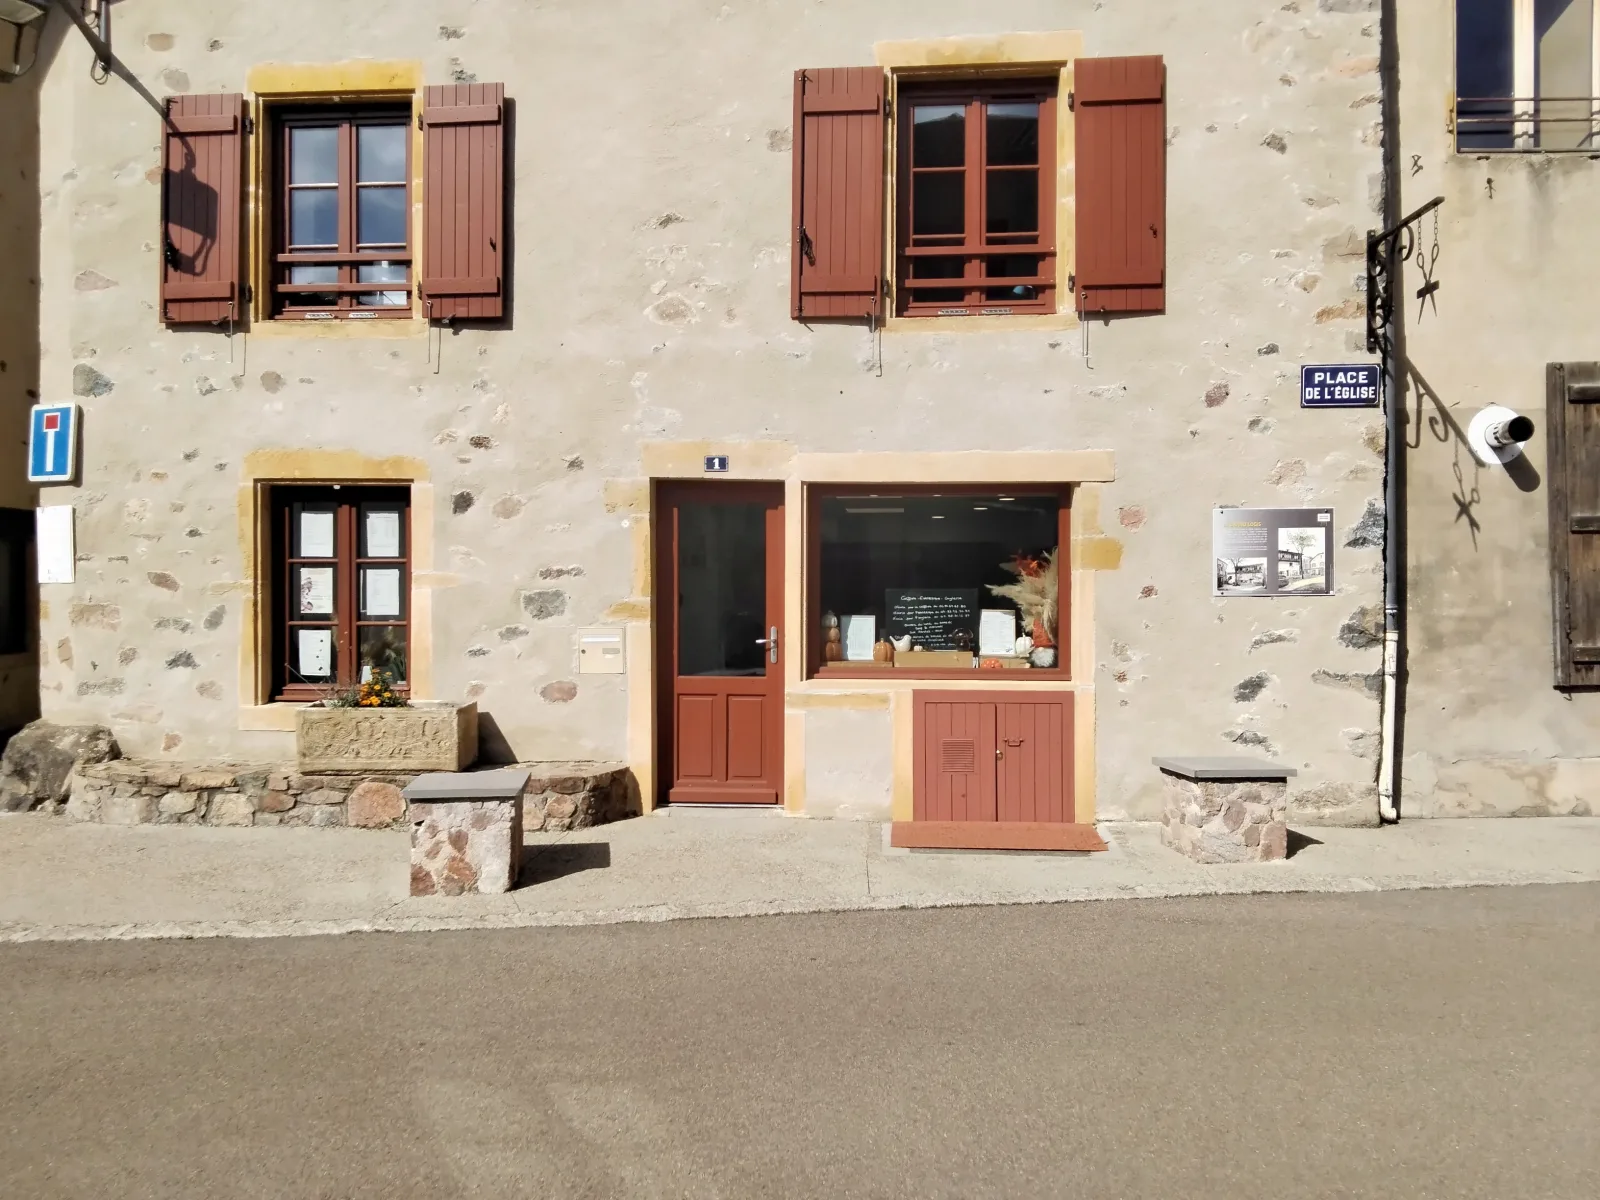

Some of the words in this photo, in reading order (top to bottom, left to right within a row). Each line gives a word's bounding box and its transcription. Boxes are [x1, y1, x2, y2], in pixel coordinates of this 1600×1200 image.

[1314, 371, 1368, 384] PLACE
[1305, 387, 1321, 399] DE
[1325, 385, 1375, 399] L'ÉGLISE
[712, 457, 721, 470] 1
